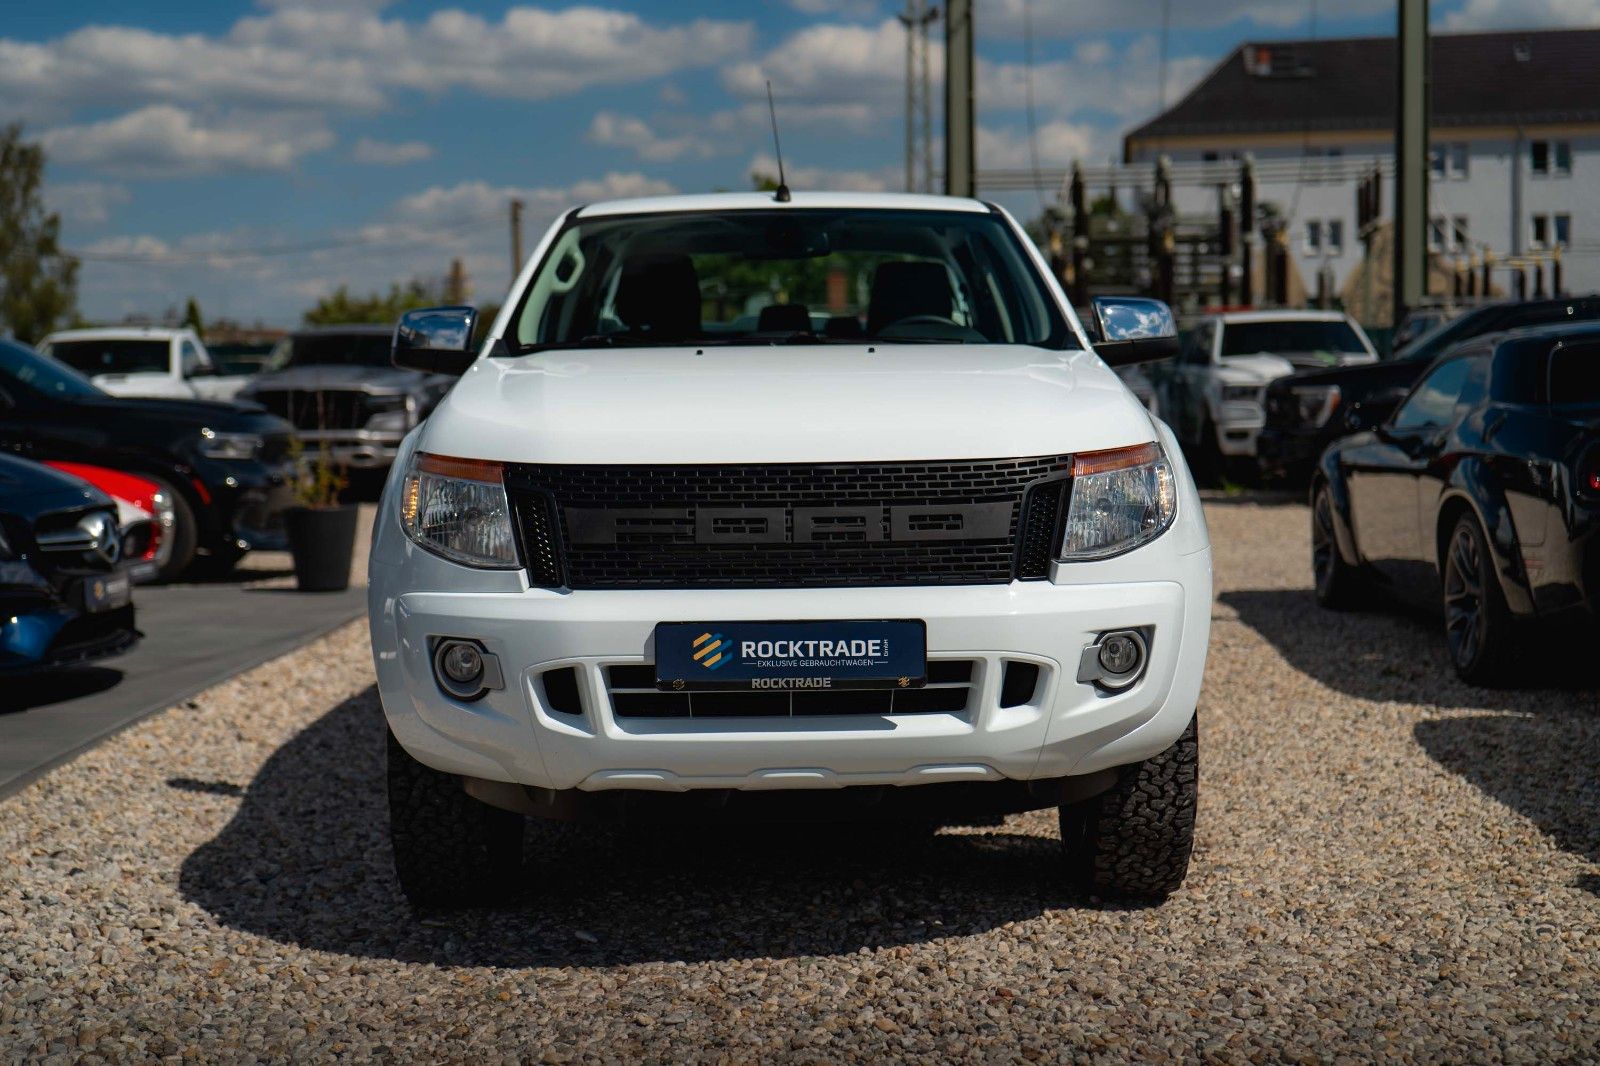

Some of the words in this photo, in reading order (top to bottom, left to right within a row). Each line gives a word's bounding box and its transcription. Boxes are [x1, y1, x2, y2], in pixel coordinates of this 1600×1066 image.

[741, 639, 882, 658] ROCKTRADE
[757, 660, 798, 668] EXKLUSIVE
[799, 659, 874, 667] GEBRAUCHTWAGEN
[751, 677, 832, 689] ROCKTRADE
